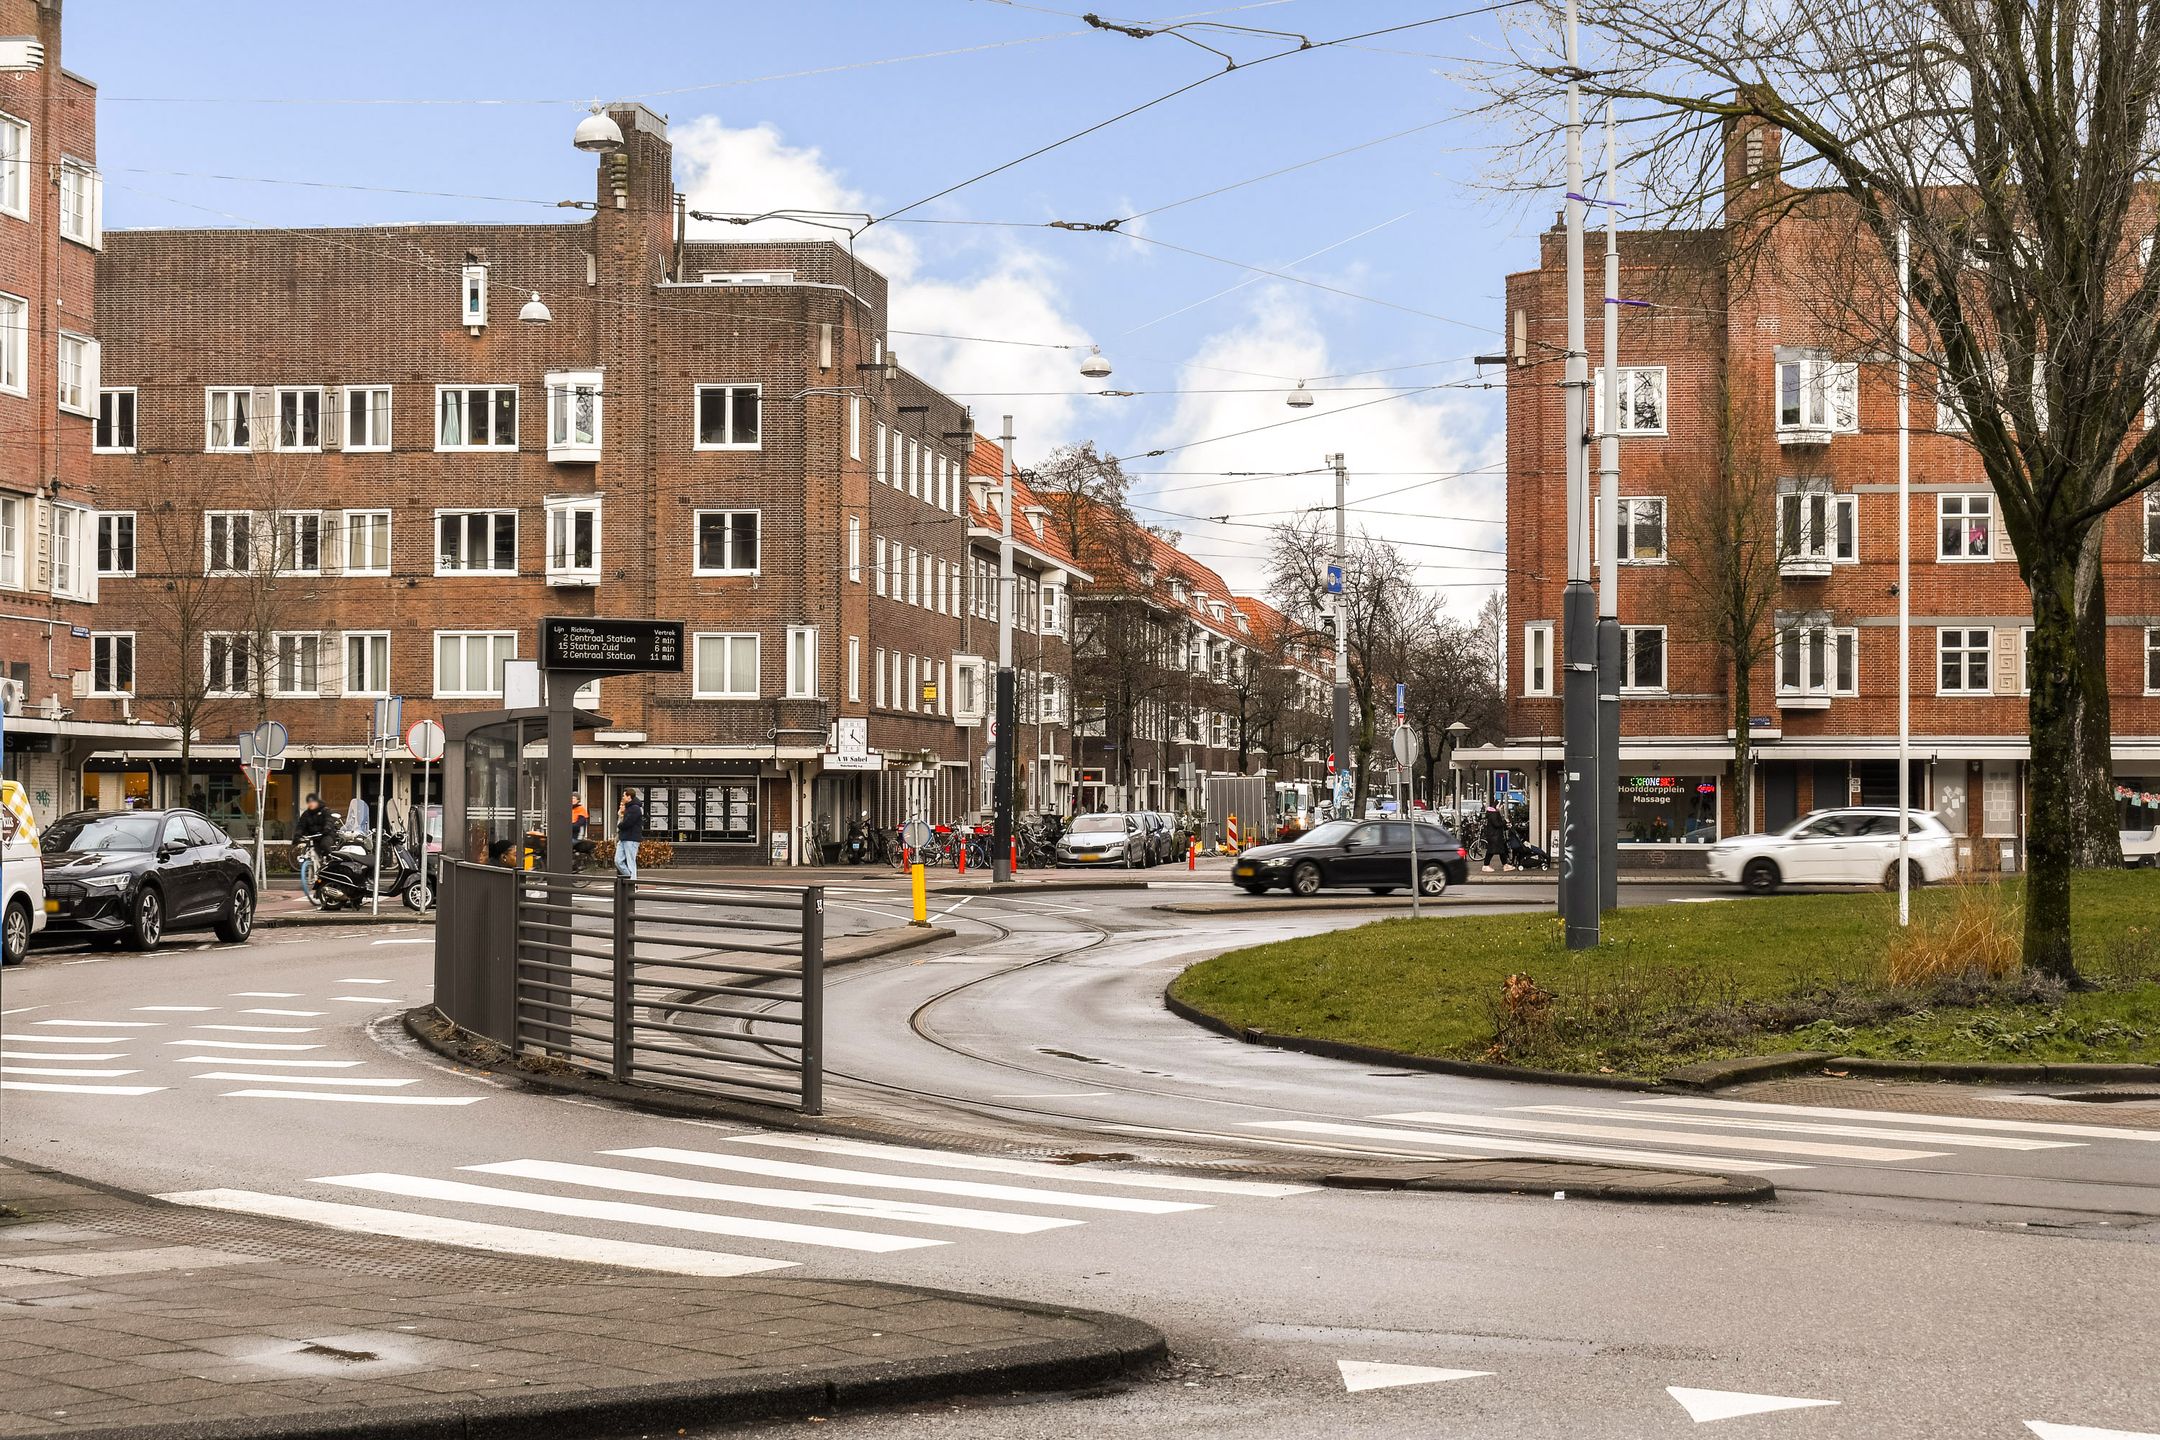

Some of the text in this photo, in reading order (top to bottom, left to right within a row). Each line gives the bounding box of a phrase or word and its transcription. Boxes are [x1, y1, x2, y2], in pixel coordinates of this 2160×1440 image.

[553, 626, 565, 634] Lijn
[570, 626, 595, 635] Richting
[563, 633, 675, 645] 2 Centraal Station 2 min
[558, 642, 675, 653] 15 Station Zuid 6 min
[562, 650, 675, 662] 2 Centraal Station 11 min
[1618, 785, 1685, 794] Hoofddorpplein
[1633, 795, 1671, 804] Massage
